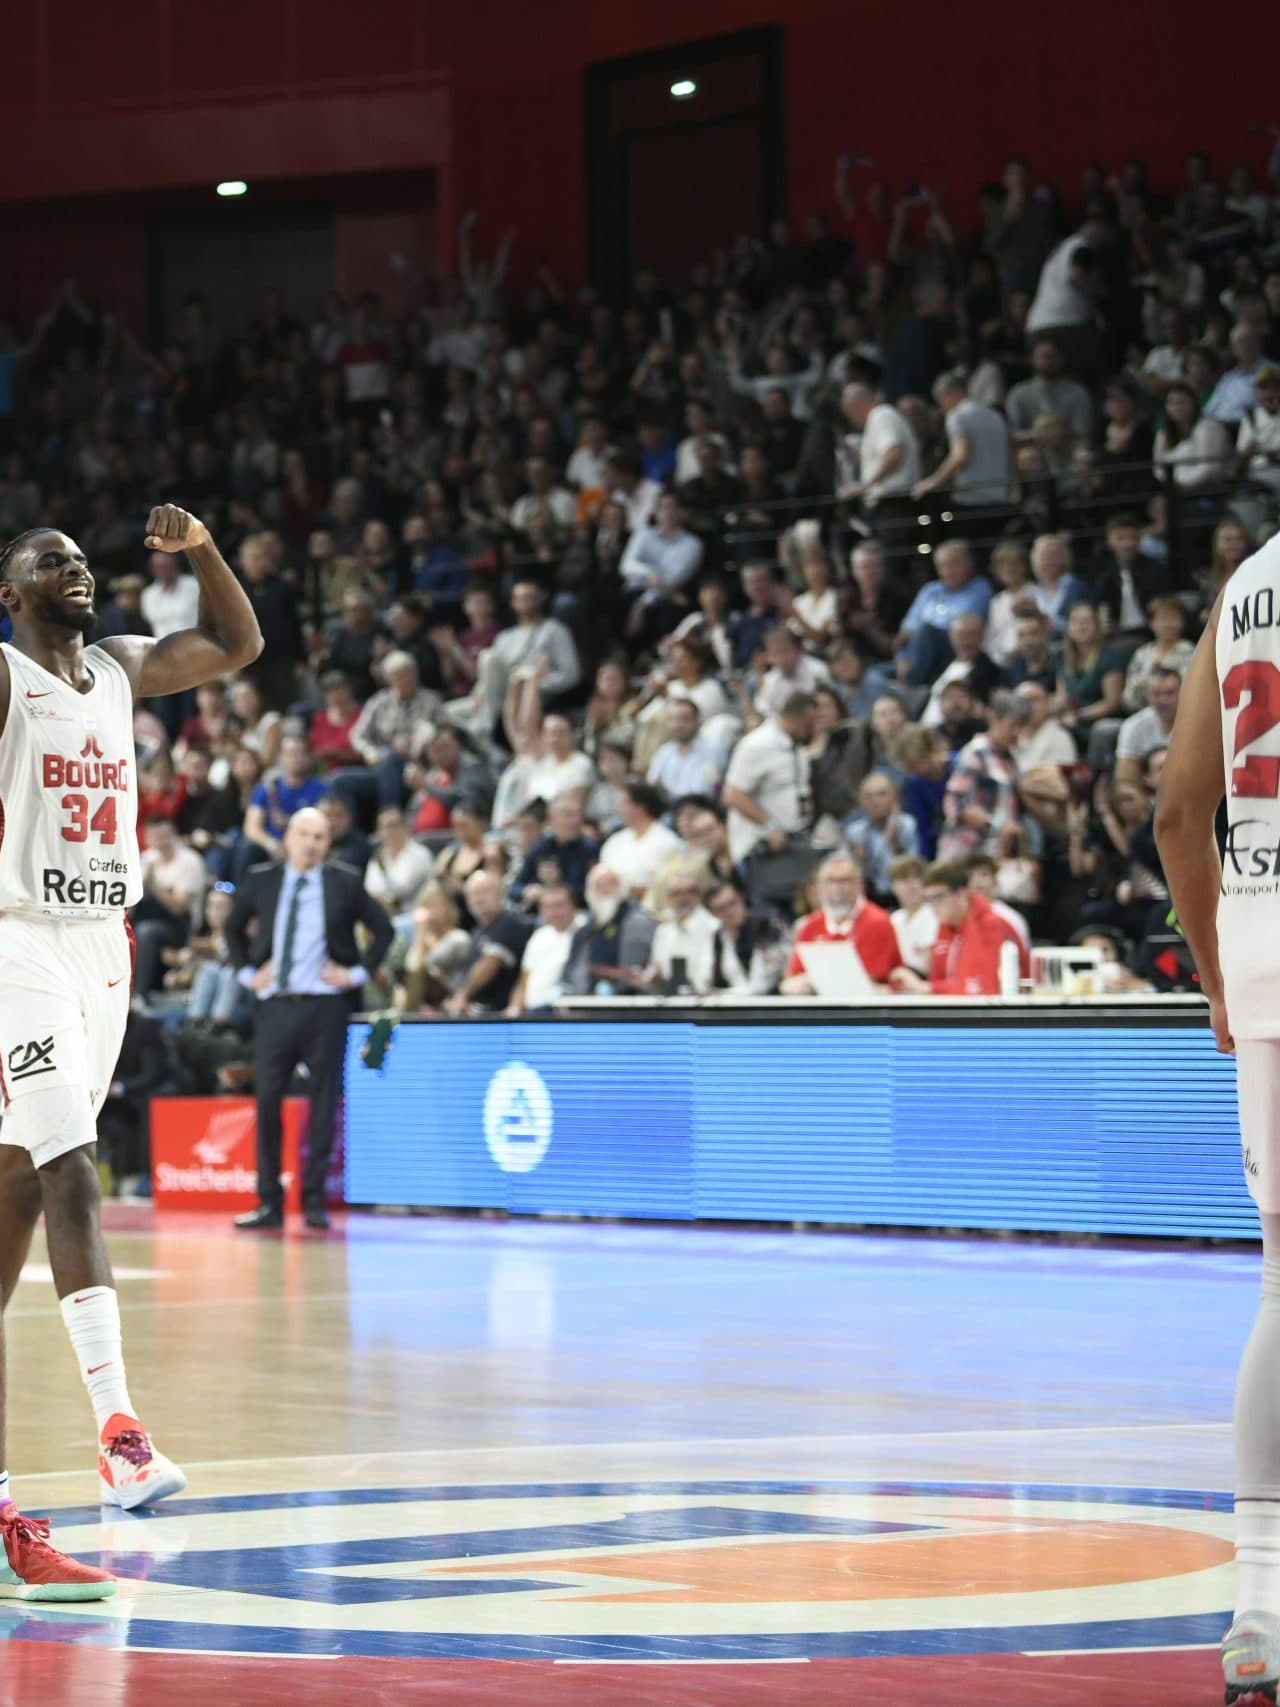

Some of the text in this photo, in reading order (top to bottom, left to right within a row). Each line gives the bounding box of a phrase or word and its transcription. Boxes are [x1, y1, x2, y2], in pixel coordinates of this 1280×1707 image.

[1231, 587, 1280, 642] MO
[60, 794, 117, 845] 34
[89, 857, 128, 874] Charles
